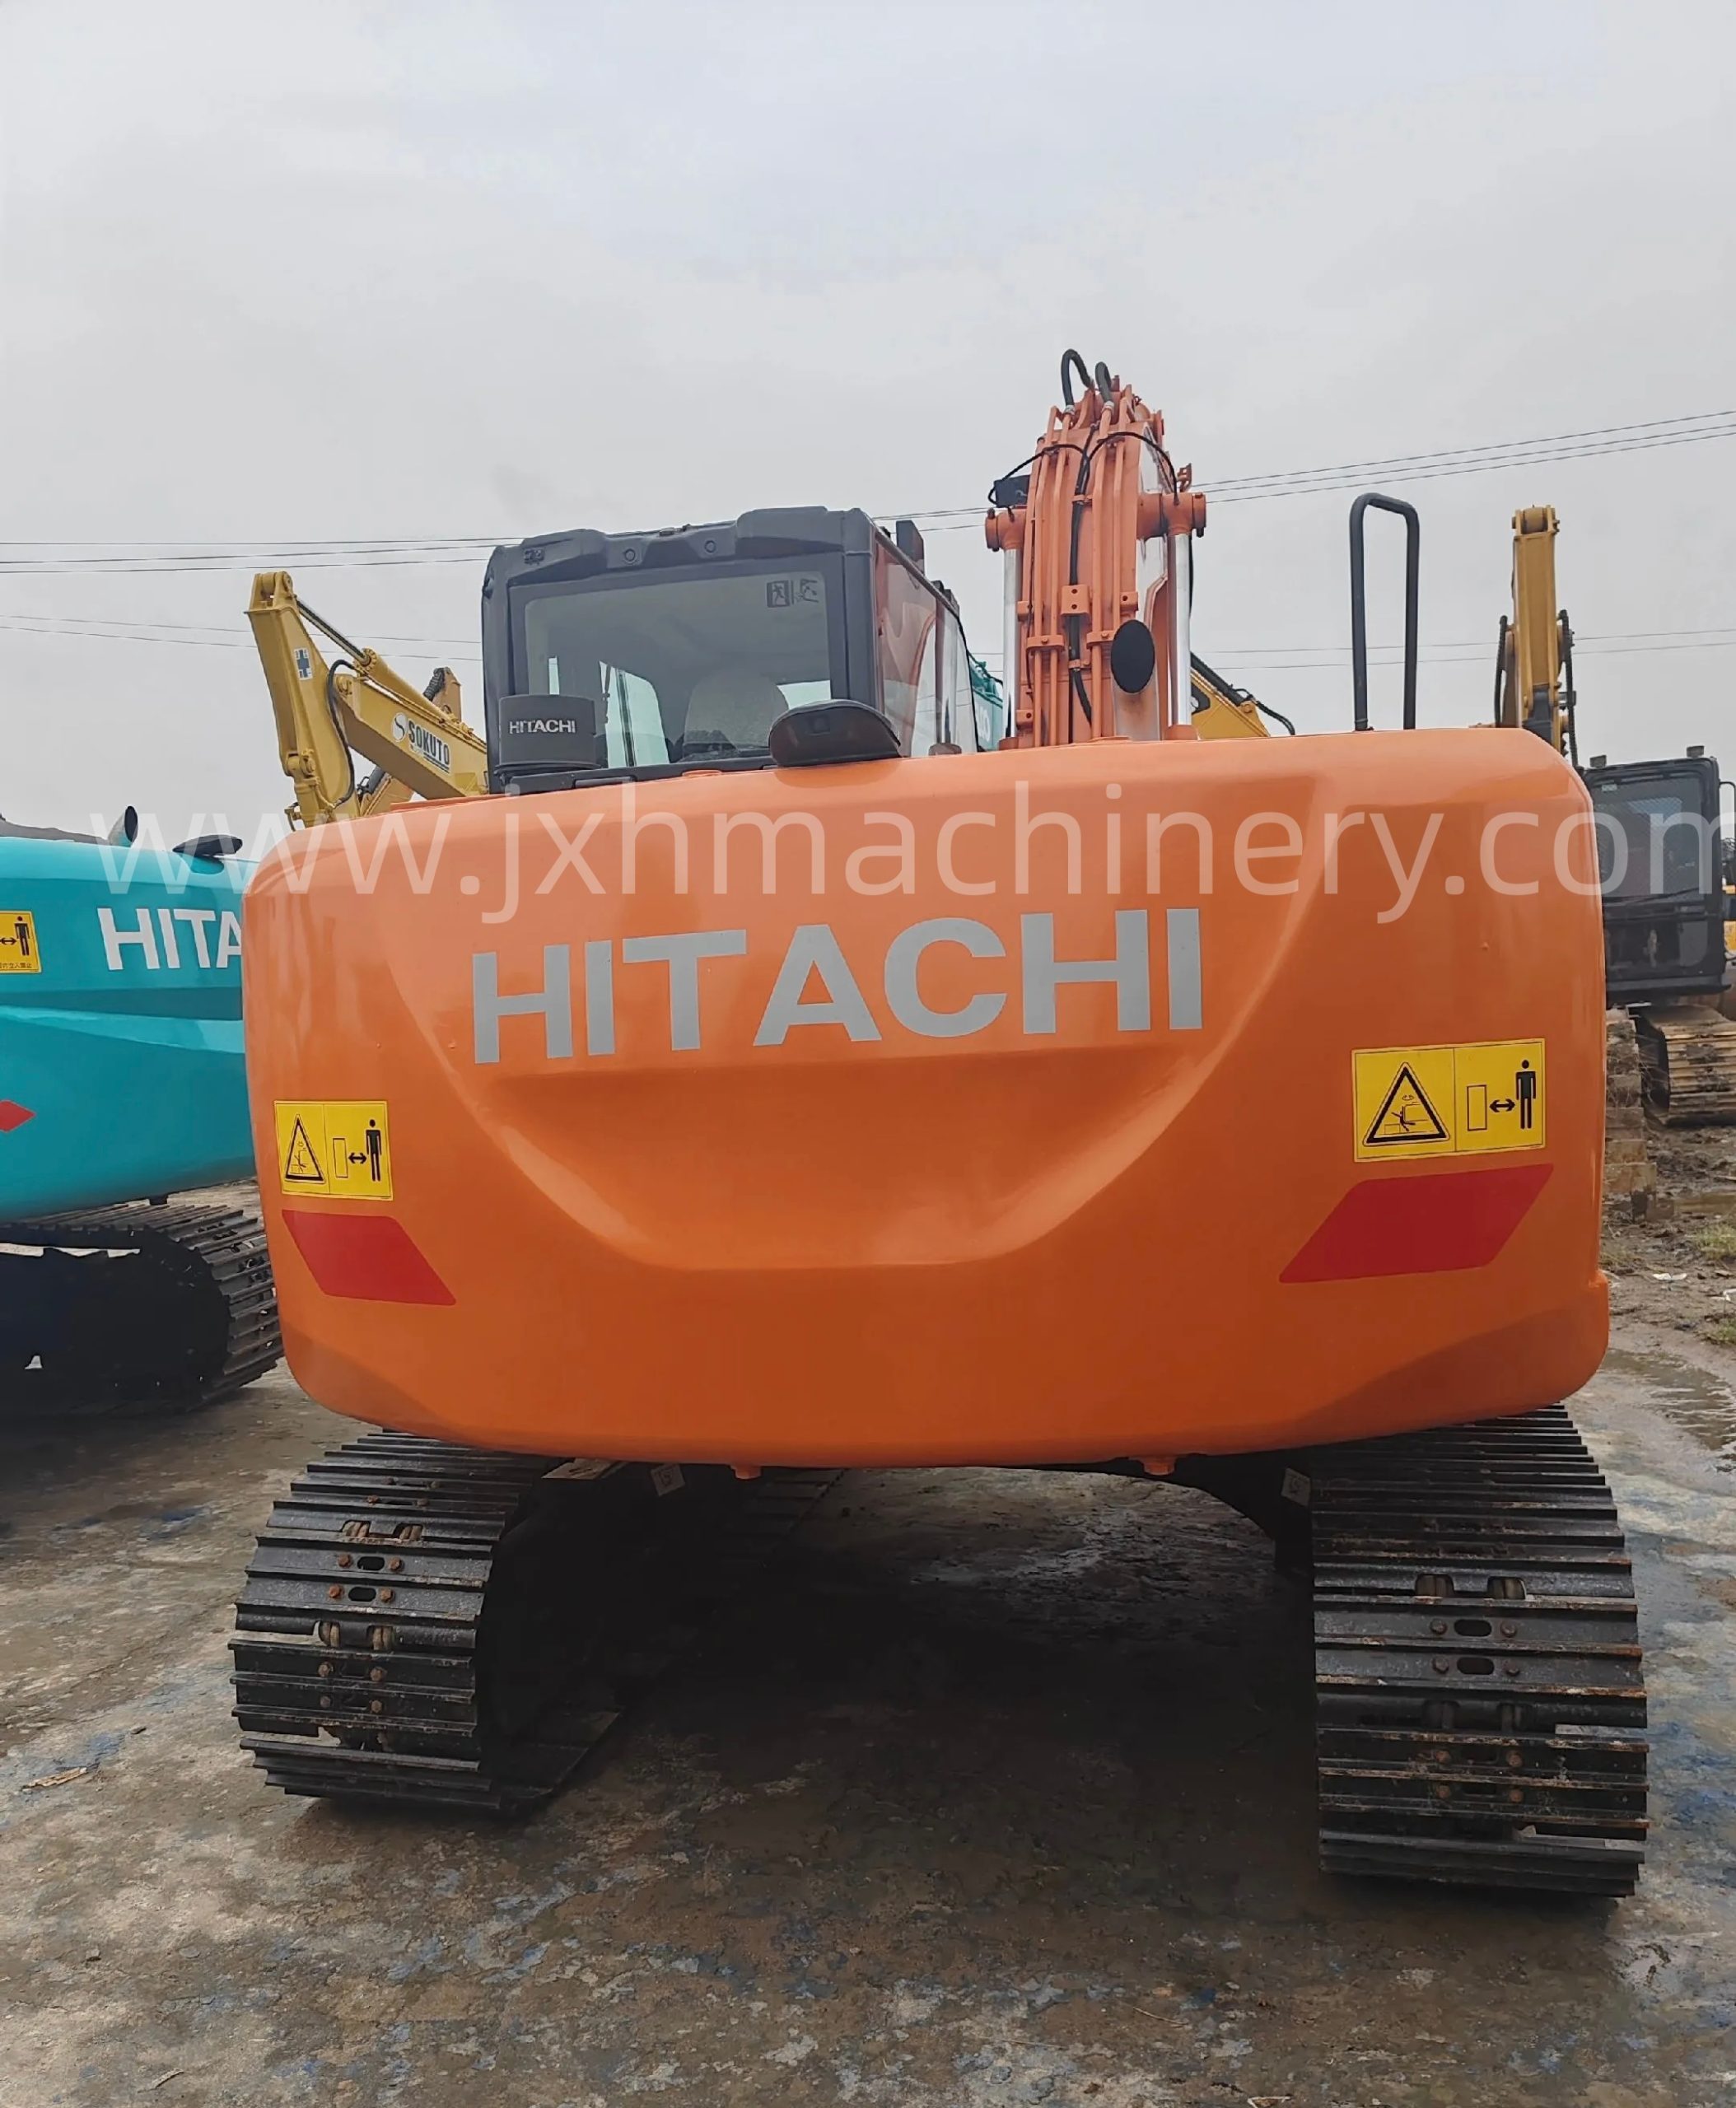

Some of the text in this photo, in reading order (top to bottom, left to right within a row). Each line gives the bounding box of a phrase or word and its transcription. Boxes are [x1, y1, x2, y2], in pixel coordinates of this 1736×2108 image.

[408, 720, 450, 765] SOKUTO
[509, 720, 576, 735] HITACHI
[472, 907, 1202, 1064] HITACHI
